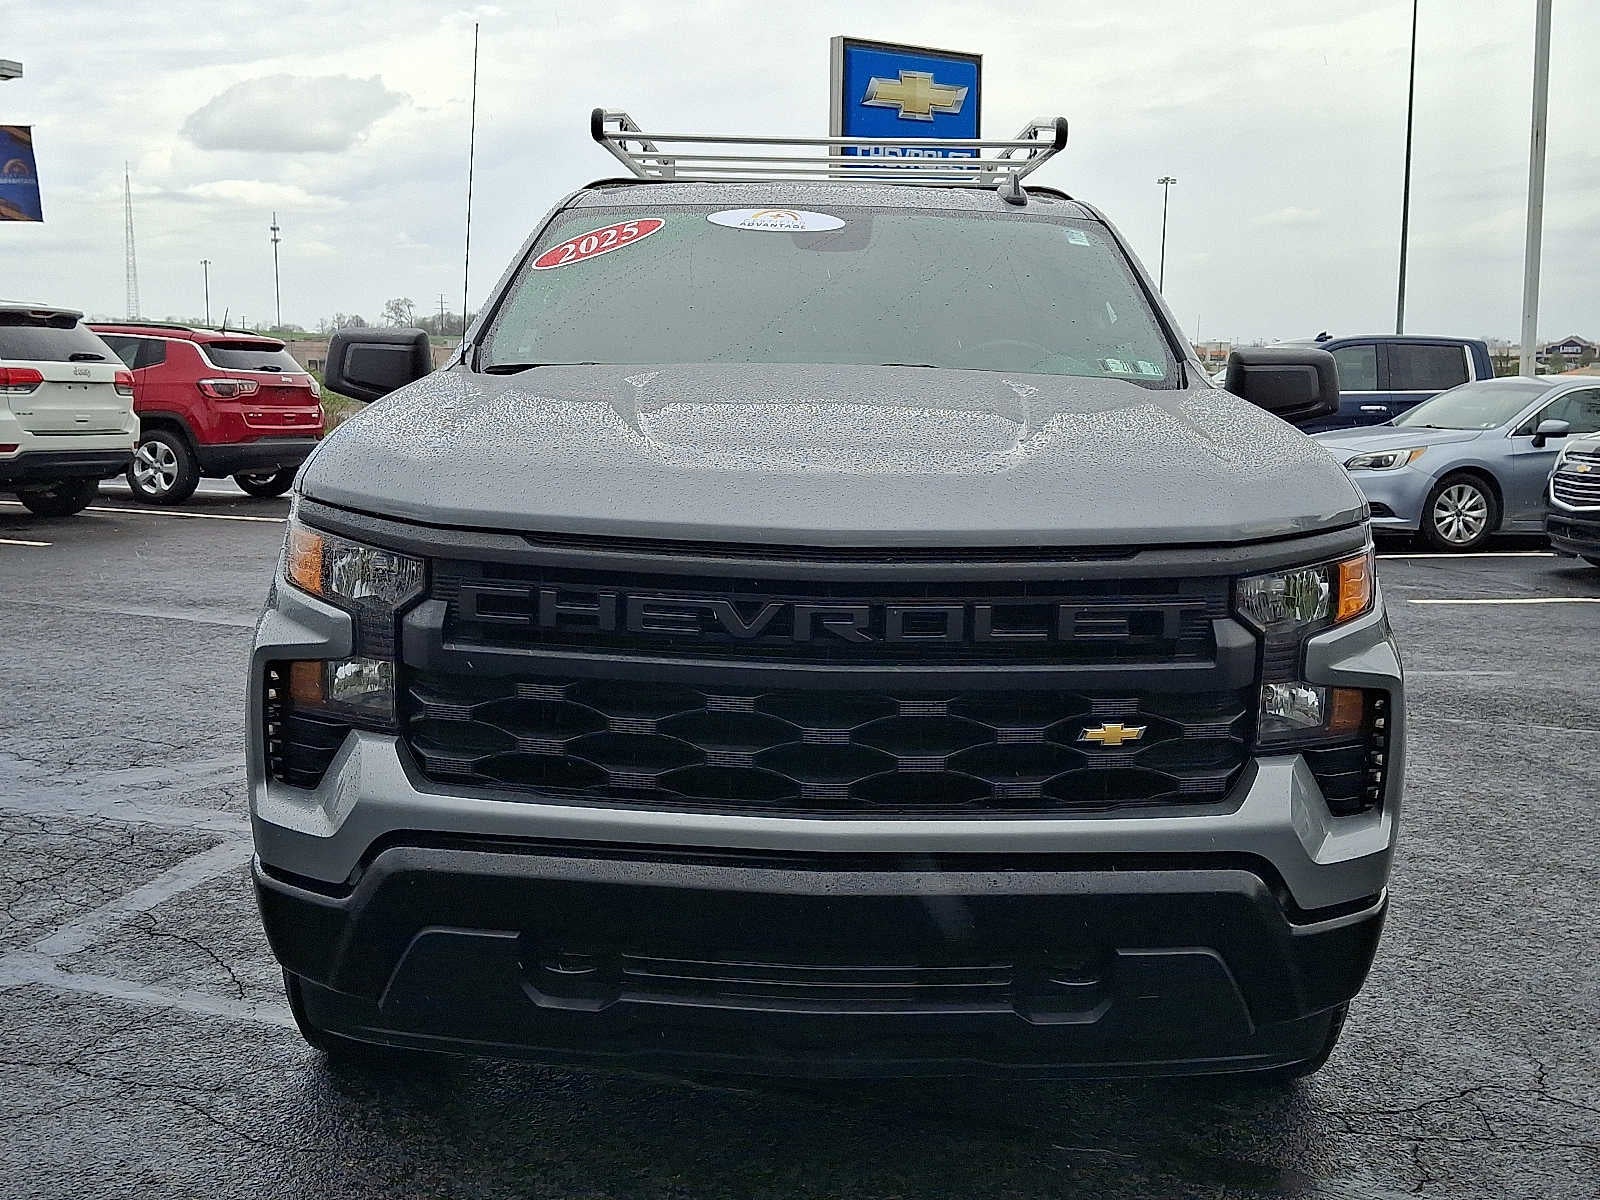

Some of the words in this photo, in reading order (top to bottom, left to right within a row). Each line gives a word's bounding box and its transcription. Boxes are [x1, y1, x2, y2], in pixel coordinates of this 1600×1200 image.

[558, 221, 639, 264] 2025
[739, 222, 806, 230] ADVANTAGE
[459, 583, 1207, 644] CHEVROLET
